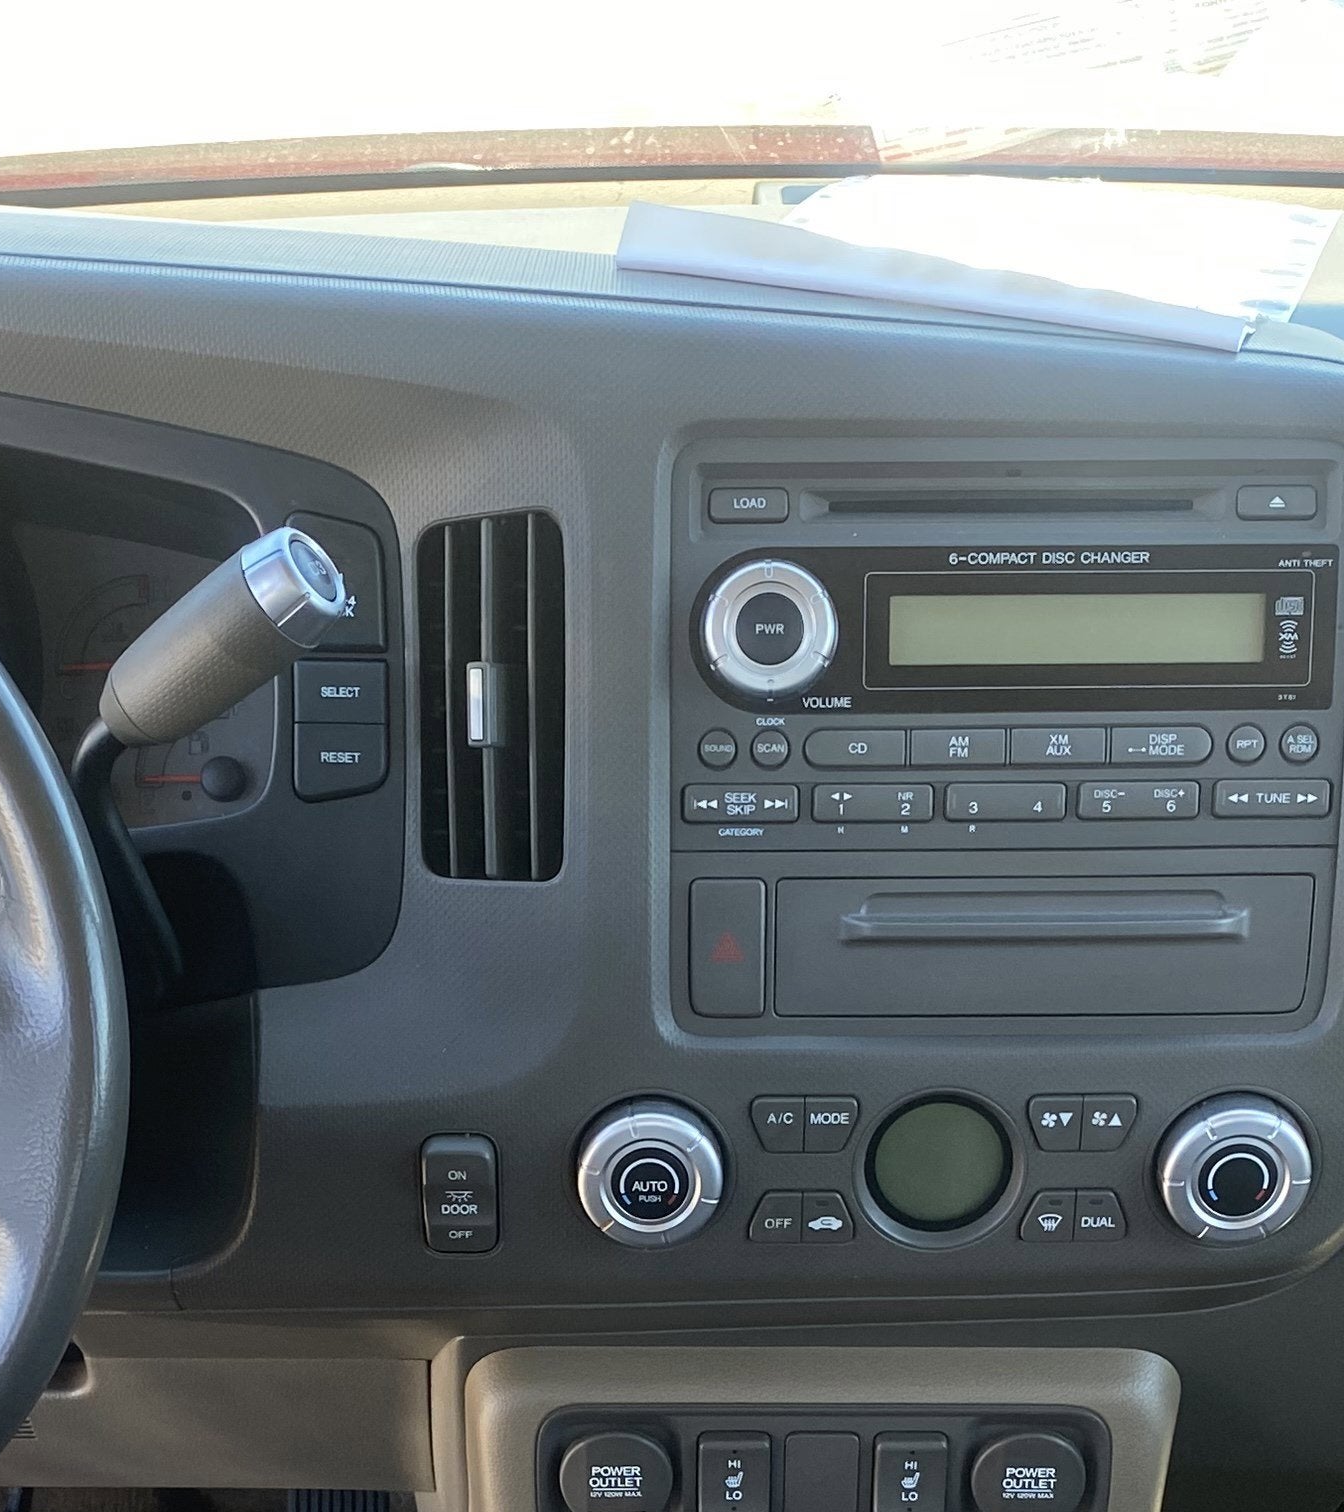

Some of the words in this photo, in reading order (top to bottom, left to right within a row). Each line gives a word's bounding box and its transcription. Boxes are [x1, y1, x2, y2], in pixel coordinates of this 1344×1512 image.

[733, 498, 766, 509] LOAD
[949, 552, 1036, 566] 6-COMPACT
[1042, 551, 1076, 565] DISC
[1080, 551, 1150, 564] CHANGER
[1278, 559, 1300, 568] ANTI
[1303, 558, 1334, 568] THEFT
[755, 623, 785, 635] PWR
[321, 687, 360, 698] SELECT
[802, 697, 852, 709] VOLUME
[756, 717, 785, 726] CLOCK
[949, 736, 970, 747] AM
[1050, 734, 1069, 745] XM
[1149, 734, 1177, 745] DISP
[1237, 740, 1258, 749] RPT
[1287, 735, 1296, 744] A
[1298, 735, 1314, 744] SEL
[704, 744, 733, 753] SOUND
[757, 743, 785, 753] SCAN
[848, 743, 868, 754] CD
[949, 747, 969, 758] FM
[1046, 745, 1072, 756] AUX
[1149, 745, 1185, 756] MODE
[1289, 744, 1311, 753] RDM
[321, 752, 360, 764] RESET
[724, 792, 757, 804] SEEK
[898, 792, 913, 800] NR
[1256, 793, 1291, 804] TUNE
[726, 804, 755, 815] SKIP
[838, 804, 844, 815] 1
[901, 803, 911, 816] 2
[969, 802, 979, 814] 3
[1033, 801, 1043, 812] 4
[1102, 800, 1111, 812] 5
[1166, 800, 1176, 812] 6
[718, 828, 765, 837] CATEGORY
[901, 825, 909, 833] M
[969, 825, 976, 833] R
[767, 1112, 794, 1124] A/C
[810, 1112, 850, 1124] MODE
[448, 1170, 467, 1180] ON
[632, 1181, 668, 1192] AUTO
[639, 1195, 662, 1203] PUSH
[441, 1204, 478, 1215] DOOR
[764, 1218, 792, 1229] OFF
[1081, 1216, 1116, 1228] DUAL
[449, 1230, 473, 1239] OFF
[727, 1460, 741, 1469] HI
[904, 1461, 918, 1470] HI
[591, 1466, 641, 1477] POWER
[1006, 1467, 1056, 1478] POWER
[589, 1477, 643, 1488] OUTLET
[1002, 1478, 1058, 1489] OUTLET
[725, 1491, 742, 1500] LO
[901, 1492, 918, 1501] LO
